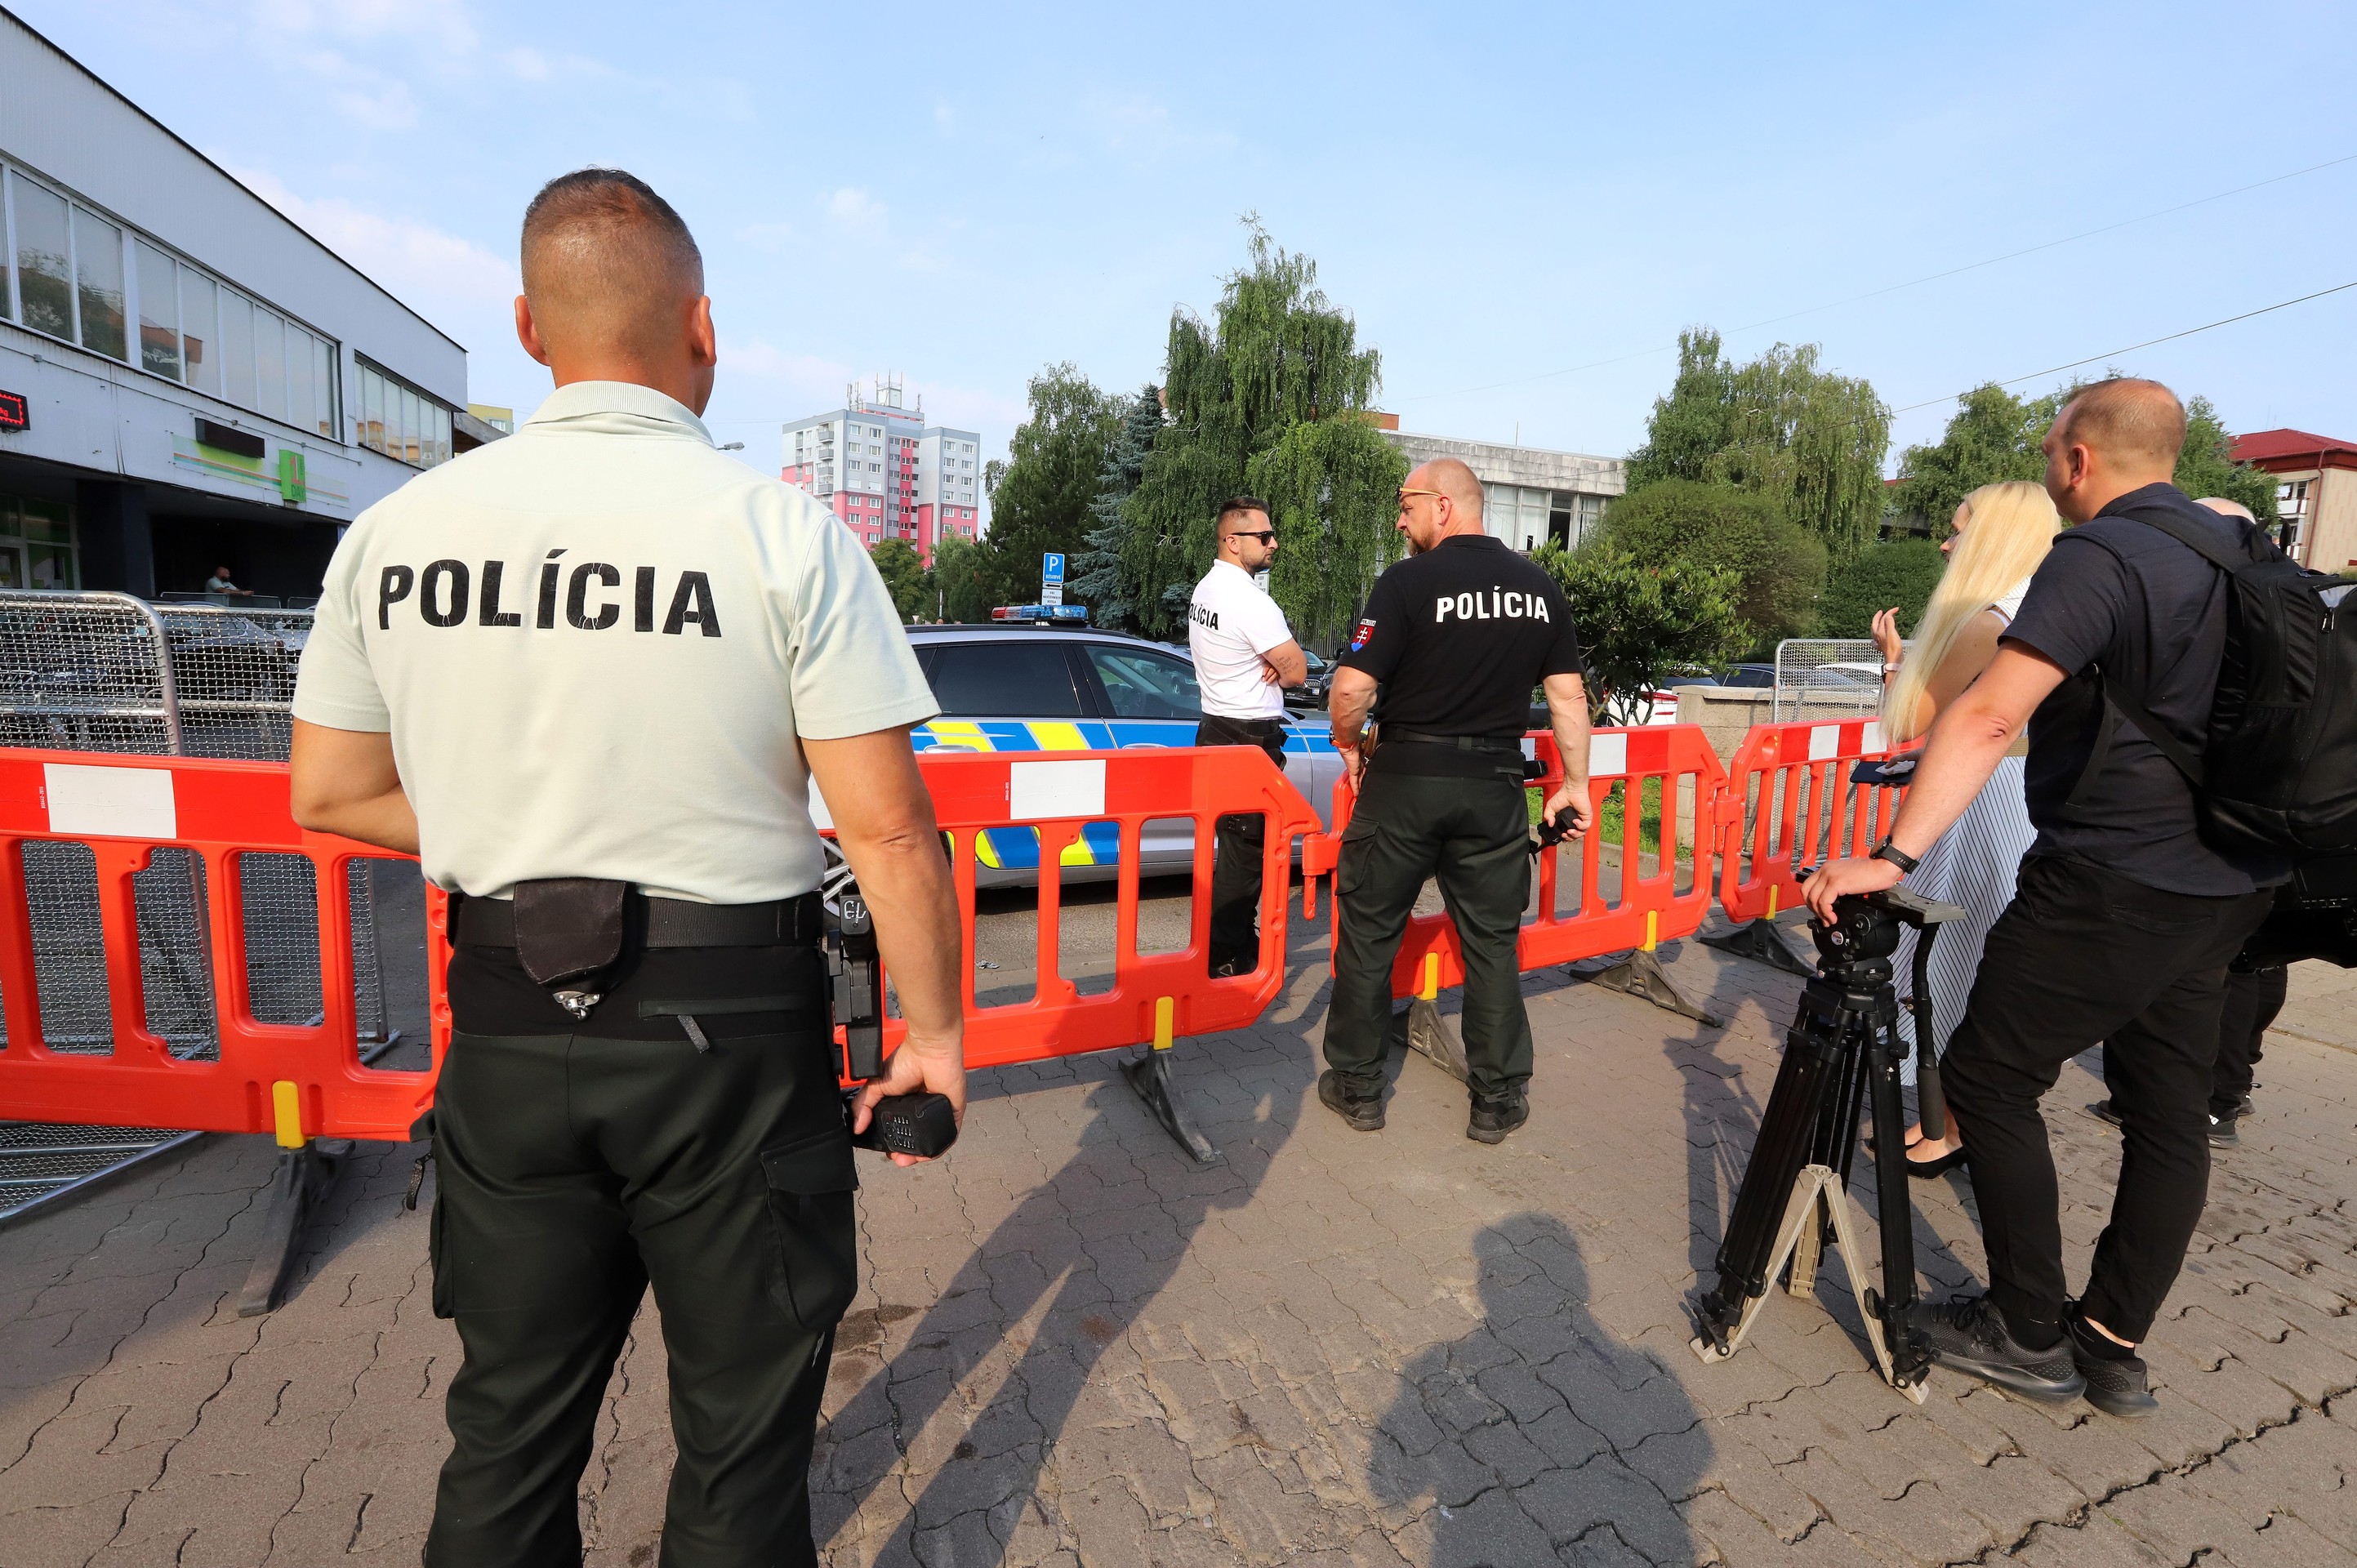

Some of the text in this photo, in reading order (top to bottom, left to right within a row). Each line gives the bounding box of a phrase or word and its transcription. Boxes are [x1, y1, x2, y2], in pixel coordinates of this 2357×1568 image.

[1049, 555, 1059, 572] P
[378, 548, 722, 638] POLÍCIA
[1436, 585, 1550, 624] POLÍCIA
[1189, 603, 1219, 630] OLÍCIA
